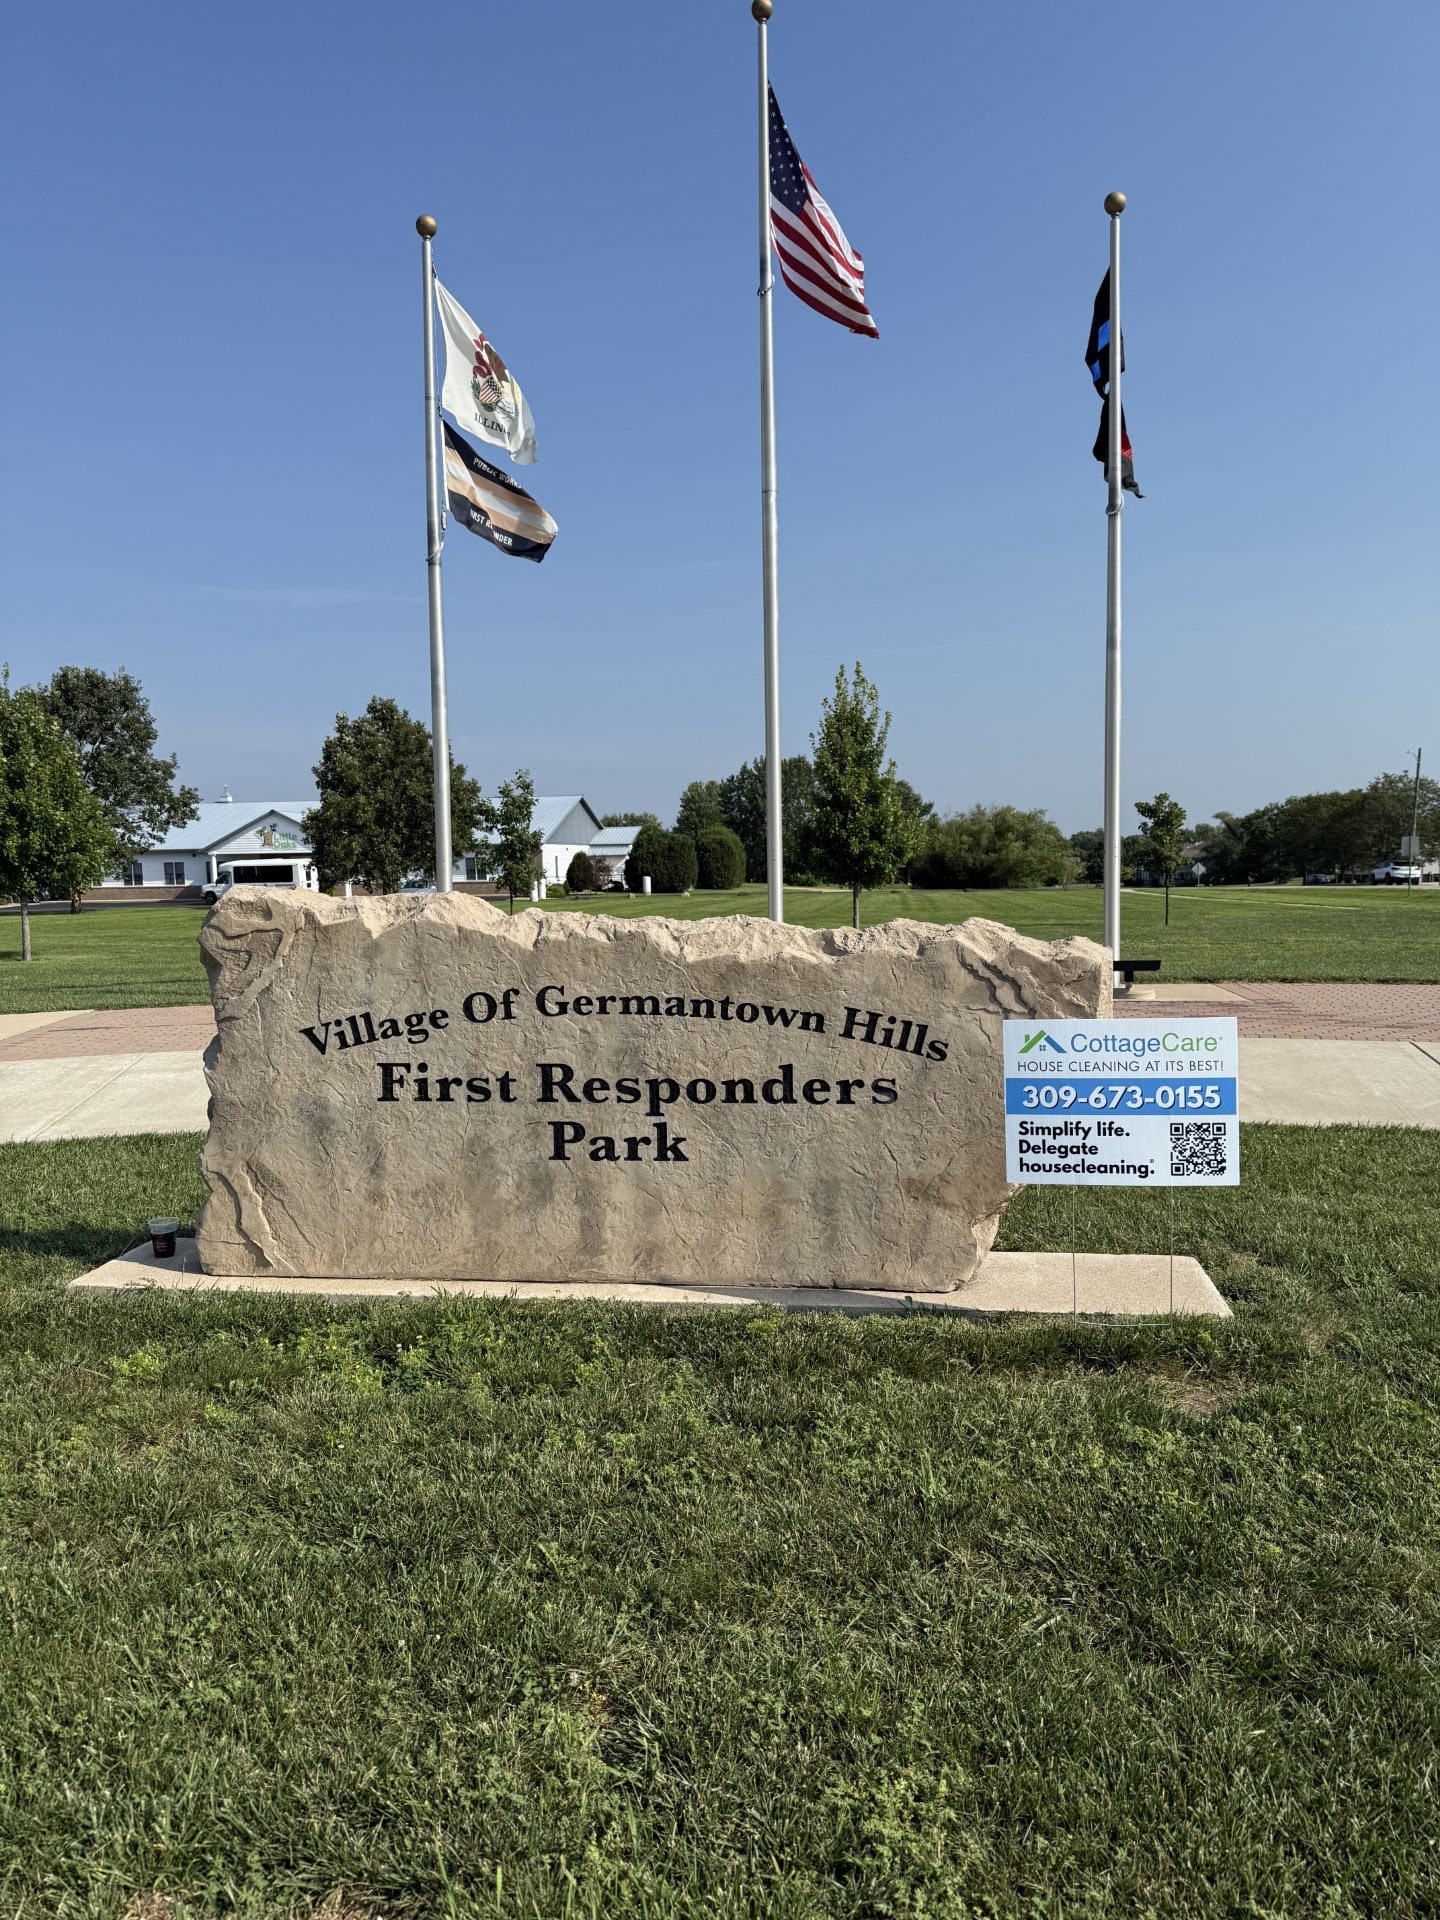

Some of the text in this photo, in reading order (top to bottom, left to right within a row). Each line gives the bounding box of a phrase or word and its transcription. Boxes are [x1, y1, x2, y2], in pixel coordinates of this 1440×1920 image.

[474, 412, 511, 439] ILLIN
[473, 457, 498, 477] PUBLIC
[470, 508, 513, 547] IRST RNDER
[274, 832, 297, 840] Little
[274, 840, 296, 848] Oaks
[299, 985, 949, 1062] Village Of Germantown Hills
[1070, 1032, 1218, 1058] CottageCare
[1017, 1060, 1225, 1072] HOUSE CLEANING AT ITS BEST!
[376, 1062, 898, 1117] First Responders
[1022, 1085, 1222, 1110] 309-673-0155
[547, 1121, 689, 1162] Park
[1018, 1121, 1131, 1140] Simplify life.
[1019, 1140, 1099, 1159] Delegate
[1019, 1158, 1155, 1179] housecleaning.
